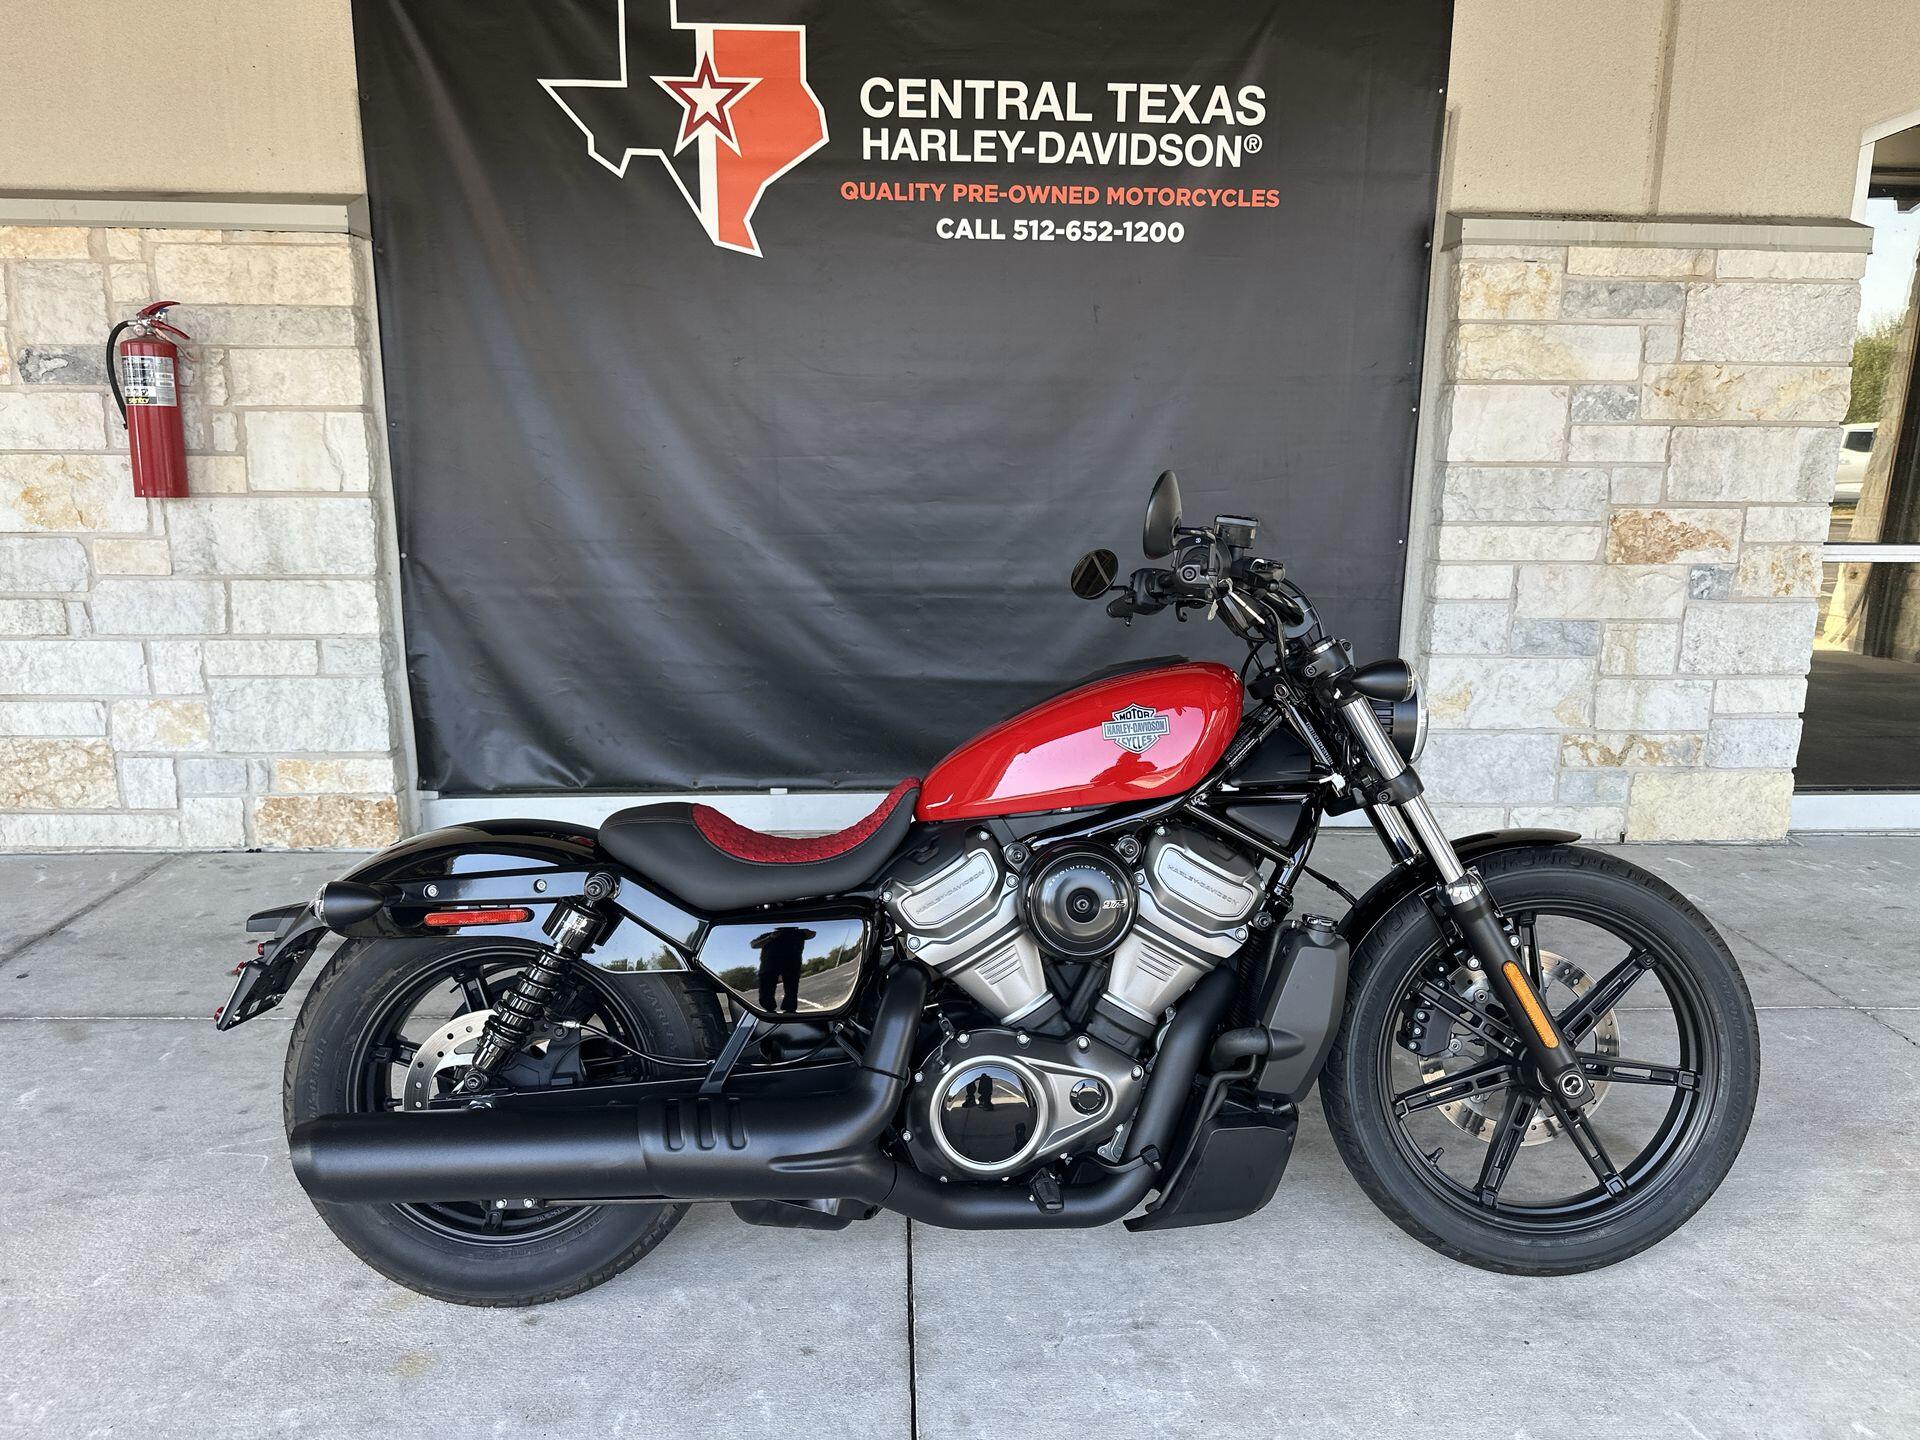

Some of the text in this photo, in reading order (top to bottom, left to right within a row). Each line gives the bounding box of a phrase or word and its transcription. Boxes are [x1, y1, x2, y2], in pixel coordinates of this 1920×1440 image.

[860, 76, 1266, 126] CENTRAL TEXAS
[840, 181, 1280, 208] QUALITY PRE-OWNED MOTORCYCLES
[935, 217, 1185, 243] CALL 512-652-1200
[1119, 708, 1150, 721] MOTOR
[1106, 720, 1165, 735] HARLEY-DAVIDSON
[1120, 735, 1153, 750] CYCLES
[1102, 898, 1128, 910] 975
